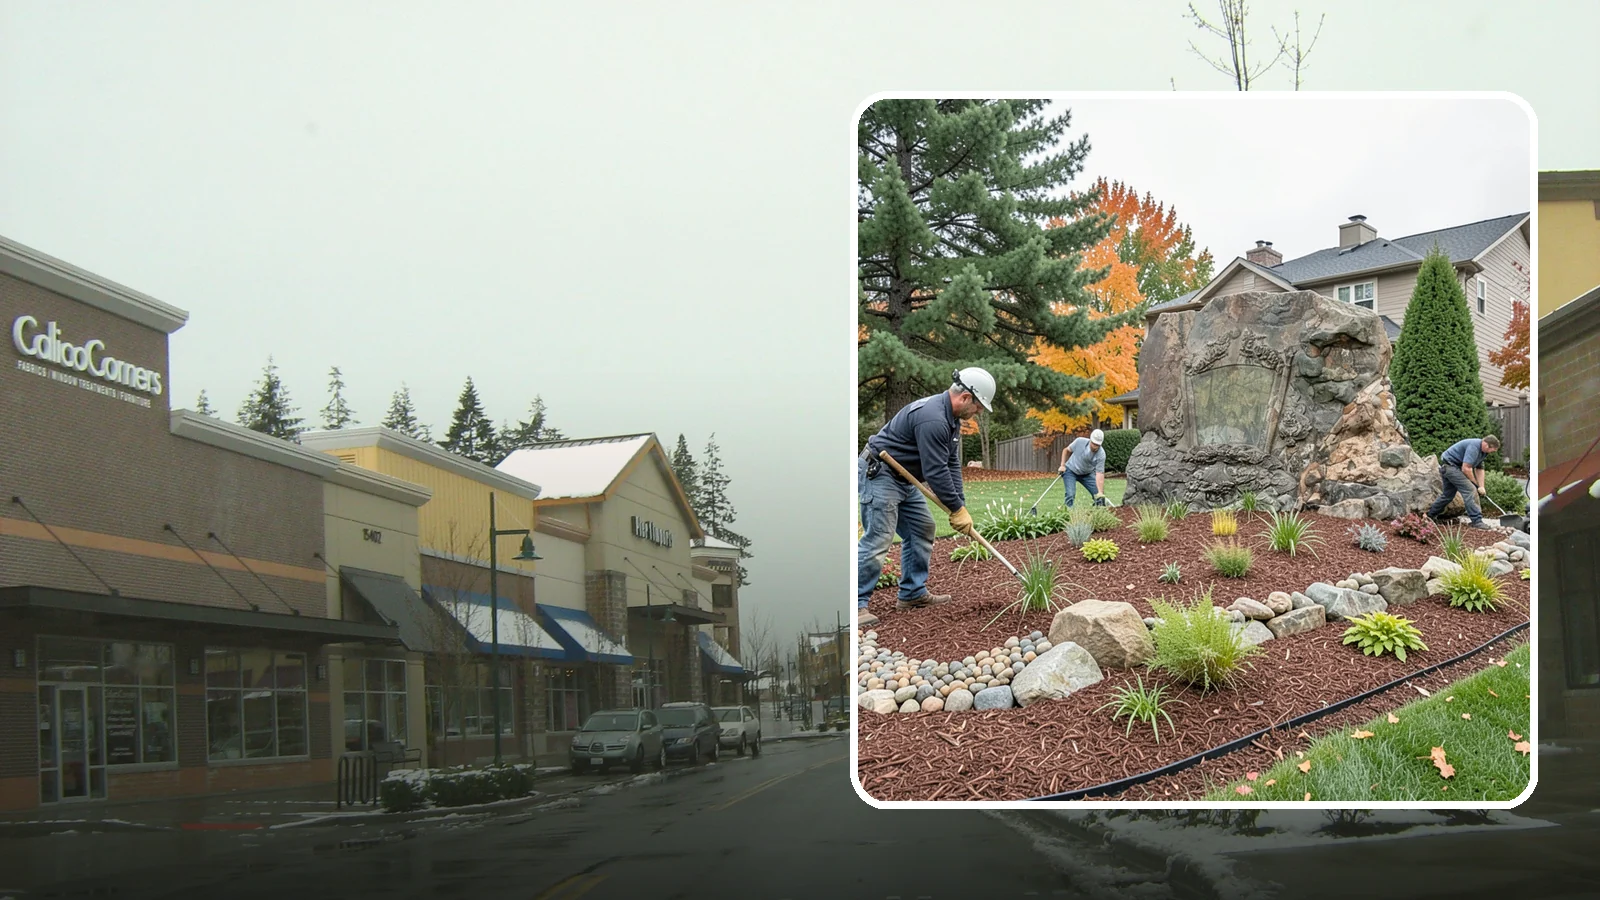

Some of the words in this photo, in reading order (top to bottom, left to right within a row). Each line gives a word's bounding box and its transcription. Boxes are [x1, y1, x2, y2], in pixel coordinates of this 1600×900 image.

[17, 360, 47, 378] FABRICS
[51, 371, 78, 387] WINDOW
[79, 378, 117, 398] TREATMENTS
[120, 391, 152, 409] FURNITURE
